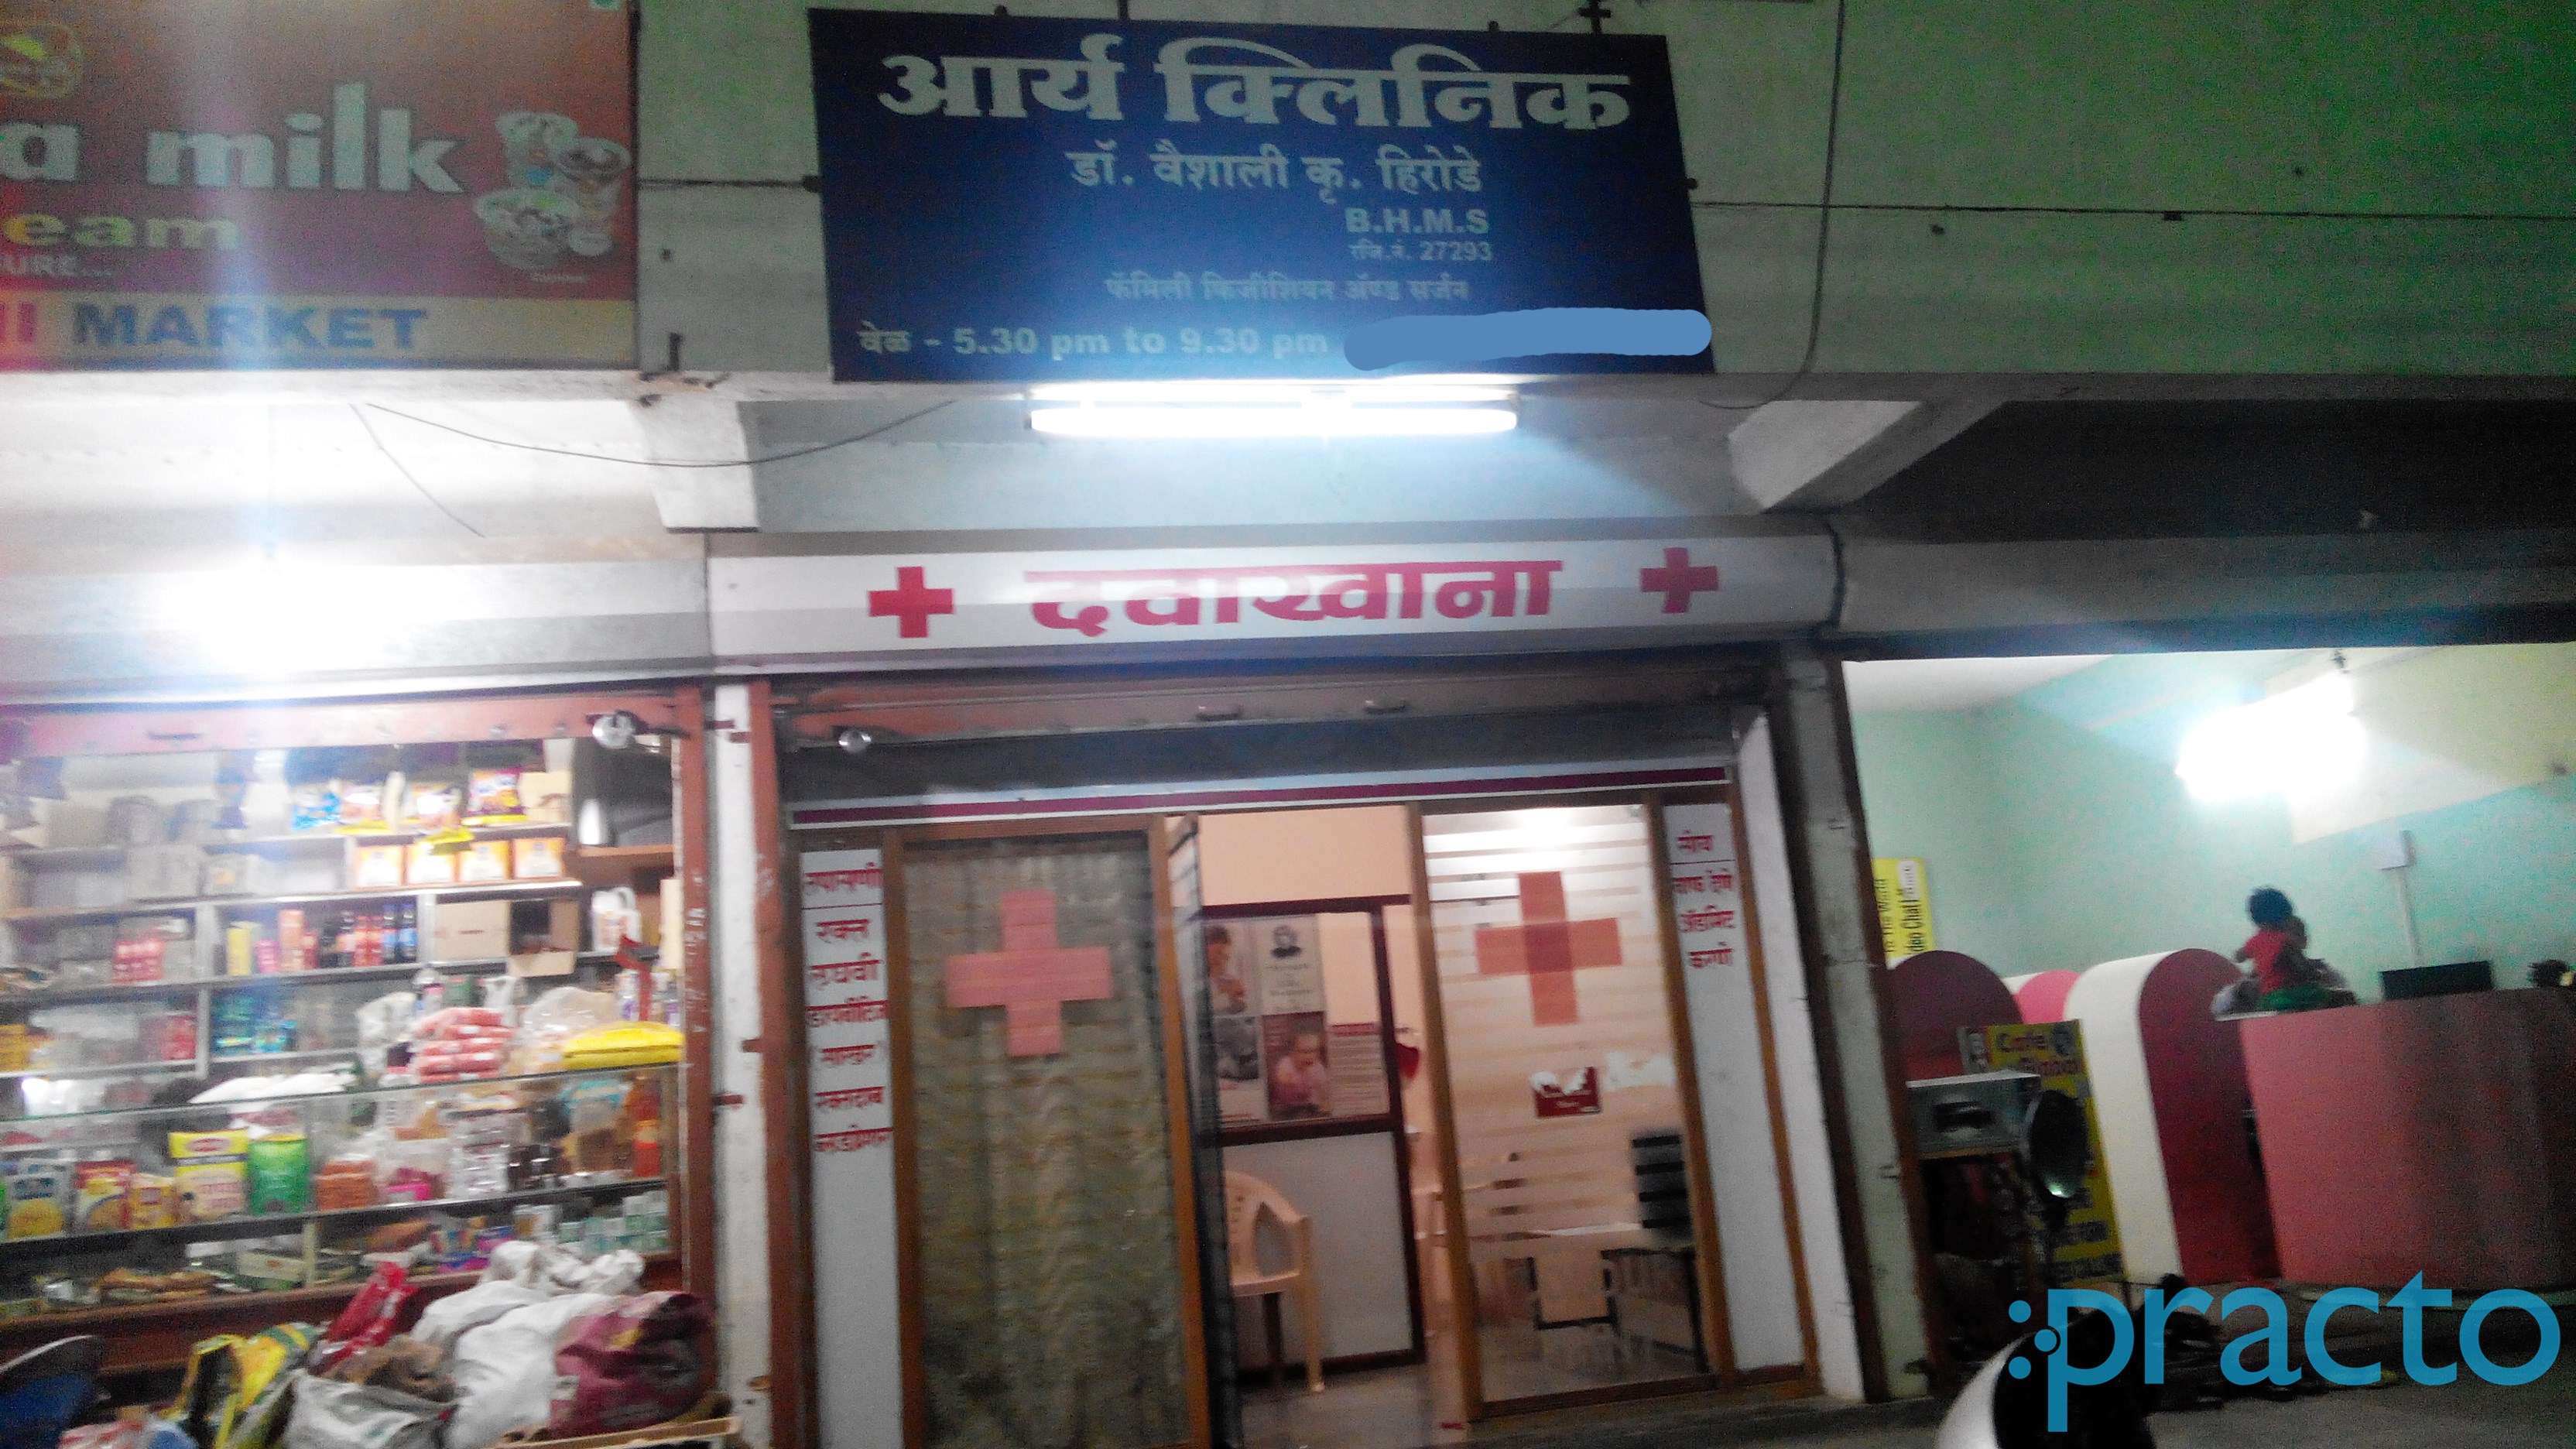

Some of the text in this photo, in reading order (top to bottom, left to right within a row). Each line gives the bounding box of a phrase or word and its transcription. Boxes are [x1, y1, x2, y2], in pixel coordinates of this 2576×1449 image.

[877, 34, 1631, 130] आर्य क्लिनिक
[146, 83, 464, 194] milk
[1065, 139, 1135, 187] डॉ.
[1149, 138, 1290, 190] वैशाली
[1374, 142, 1484, 195] हिरोडे
[1345, 206, 1489, 234] B.H.M.S
[1419, 240, 1493, 262] 27293
[74, 305, 429, 351] MARKET
[954, 327, 1038, 355] 5.30
[1051, 333, 1110, 361] pm
[1125, 327, 1166, 355] to
[1180, 327, 1260, 355] 9.30
[1272, 333, 1329, 360] pm
[1023, 559, 1564, 637] दवाखाना
